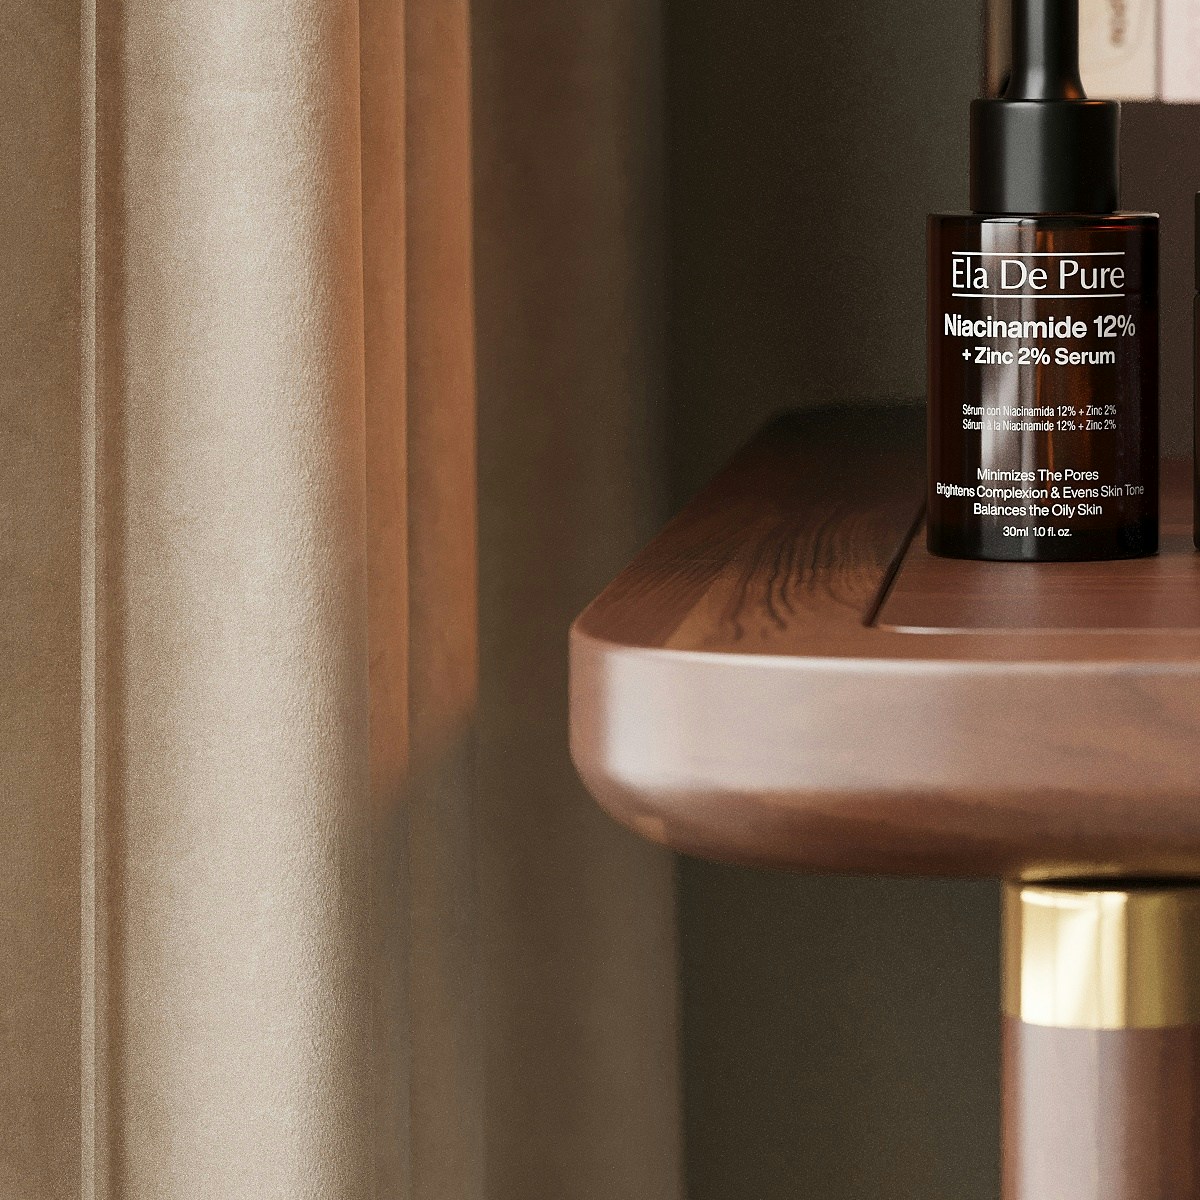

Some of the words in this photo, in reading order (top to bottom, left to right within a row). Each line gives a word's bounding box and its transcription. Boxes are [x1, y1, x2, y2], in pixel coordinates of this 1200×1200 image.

[952, 256, 990, 290] Ela
[1001, 259, 1048, 290] De
[1059, 259, 1125, 290] Pure
[944, 313, 1088, 339] Niacinamide
[1093, 314, 1136, 337] 12%
[974, 346, 1013, 365] Zinc
[1018, 348, 1050, 365] 2%
[1054, 347, 1116, 365] Serum
[962, 404, 985, 416] Sérum
[986, 406, 1001, 416] con
[1003, 405, 1055, 417] Niacinamida
[1057, 405, 1076, 417] 12%
[1086, 405, 1102, 416] Zinc
[1104, 404, 1117, 416] 2%
[962, 418, 985, 431] Sérum
[1002, 420, 1055, 432] Niacinamide
[1056, 420, 1076, 432] 12%
[1085, 420, 1102, 431] Zinc
[1103, 419, 1117, 430] 2%
[976, 468, 1036, 482] Minimizes
[1037, 469, 1063, 482] The
[1064, 469, 1099, 482] Pores
[936, 482, 975, 499] Brightens
[976, 485, 1049, 501] Complexion
[1050, 486, 1061, 499] &
[1062, 486, 1099, 499] Evens
[1100, 485, 1123, 498] Skin
[1124, 483, 1145, 496] Tone
[973, 502, 1027, 516] Balances
[1028, 503, 1050, 516] the
[1051, 503, 1076, 519] Oily
[1077, 503, 1103, 516] Skin
[1002, 526, 1029, 537] 30ml
[1032, 526, 1046, 537] 1.0
[1057, 528, 1073, 537] oz.
